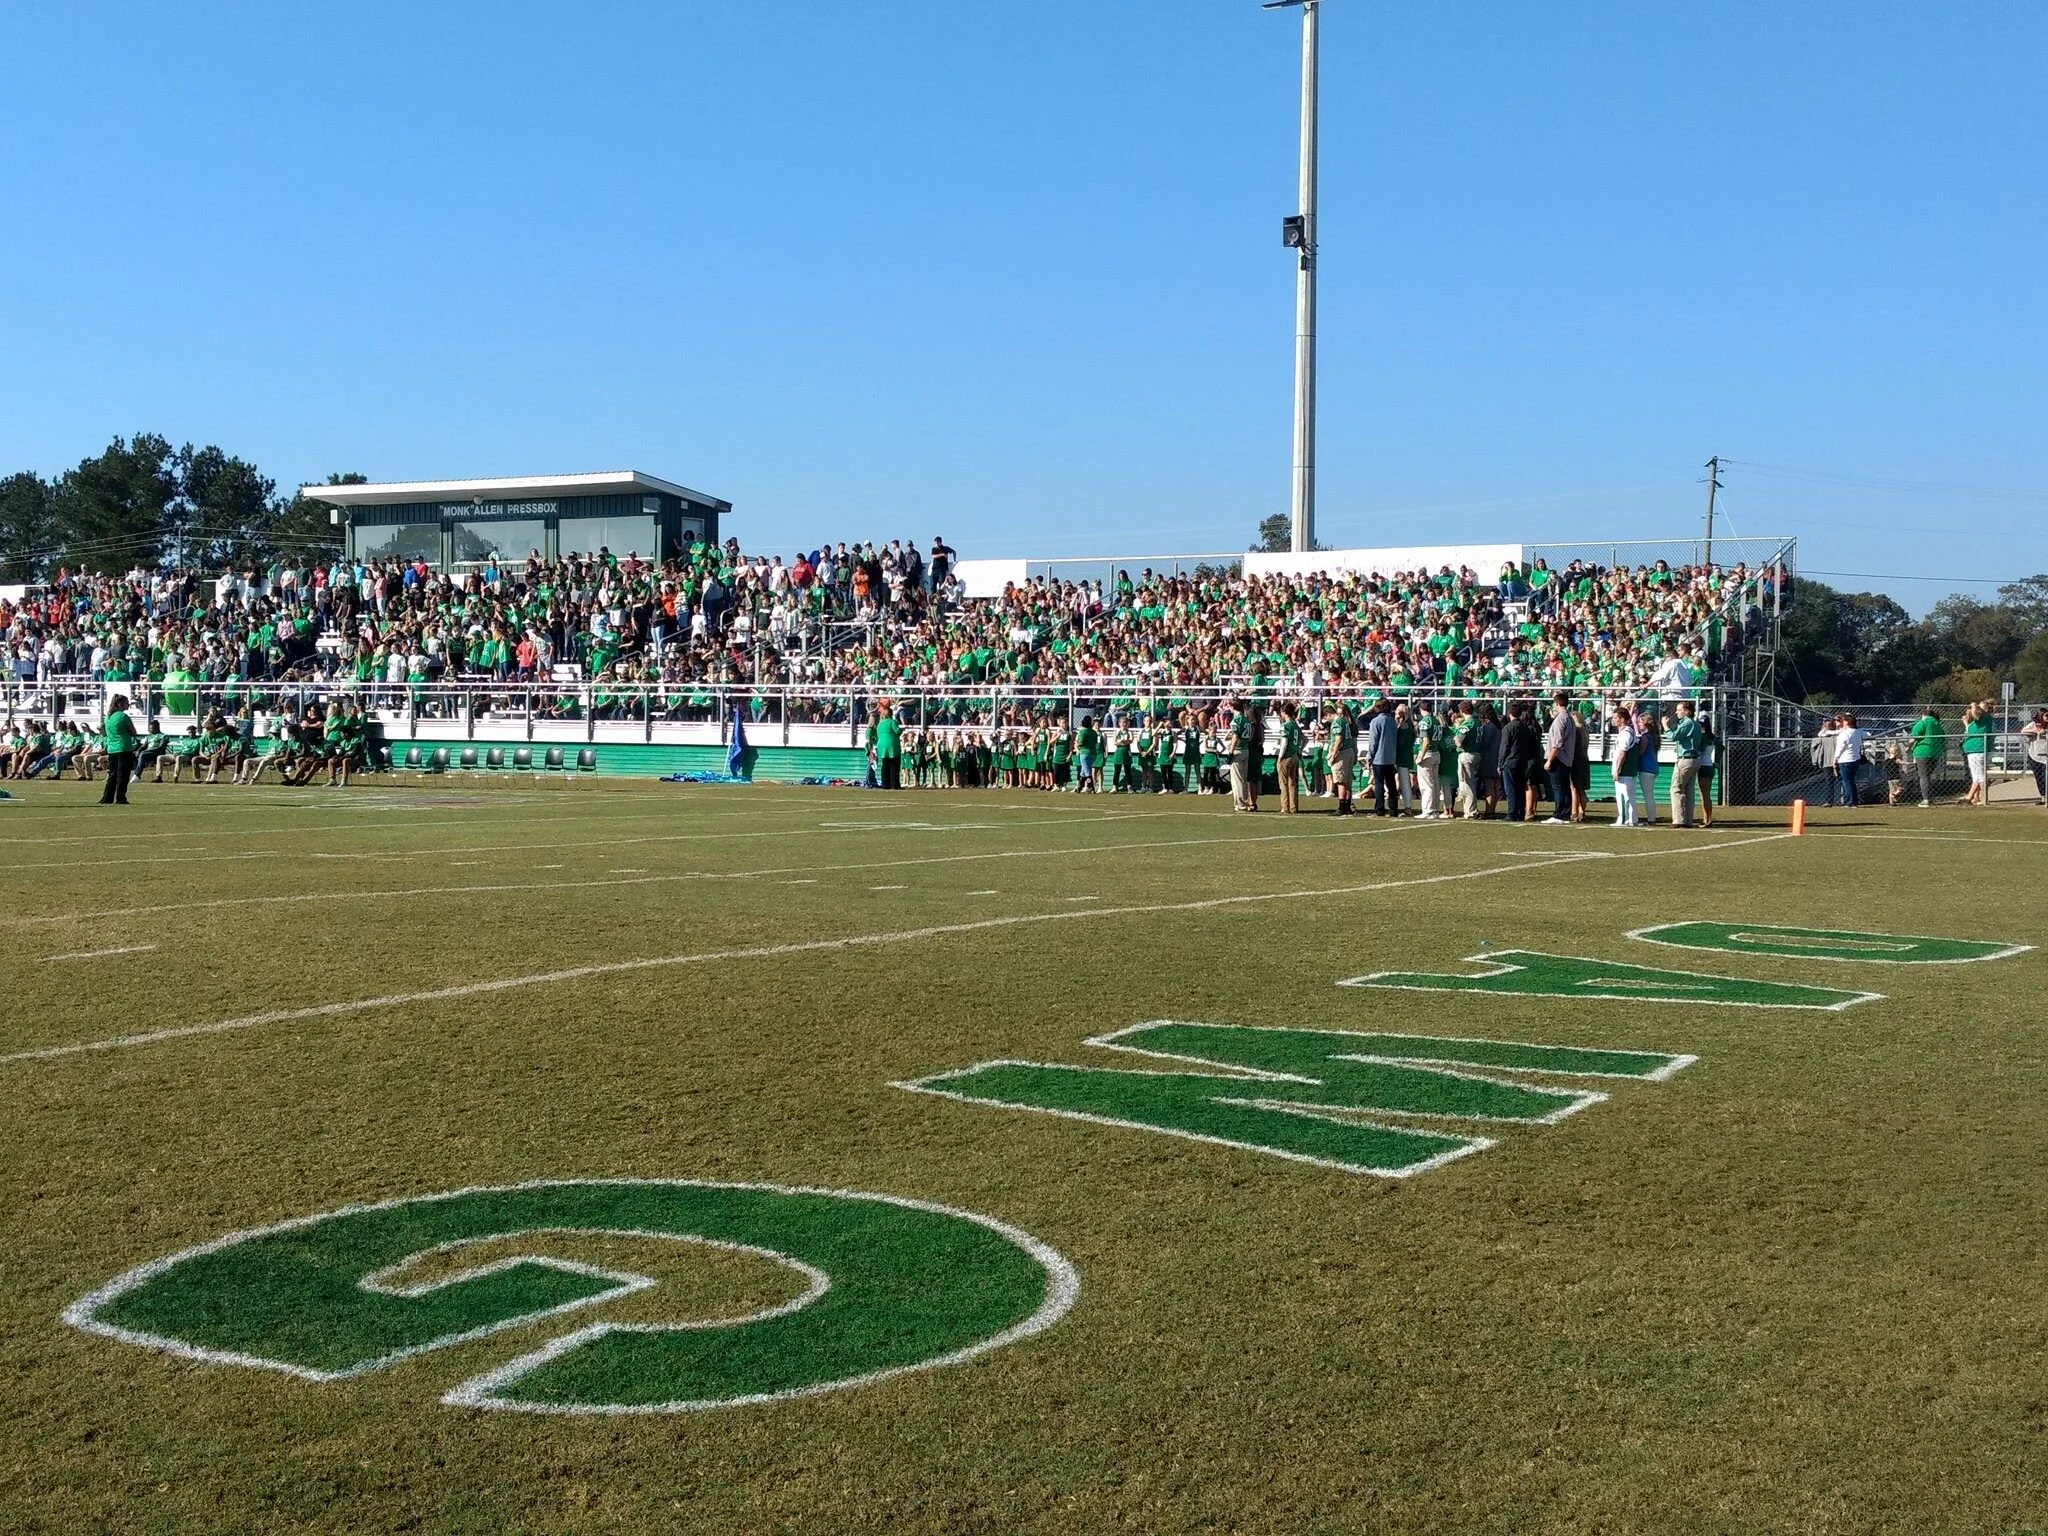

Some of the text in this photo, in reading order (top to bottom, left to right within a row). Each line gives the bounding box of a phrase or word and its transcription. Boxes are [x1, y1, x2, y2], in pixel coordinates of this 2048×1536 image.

[474, 504, 503, 515] ALLEN
[507, 502, 557, 514] PRESSBOX
[62, 918, 2035, 1416] DAWG
